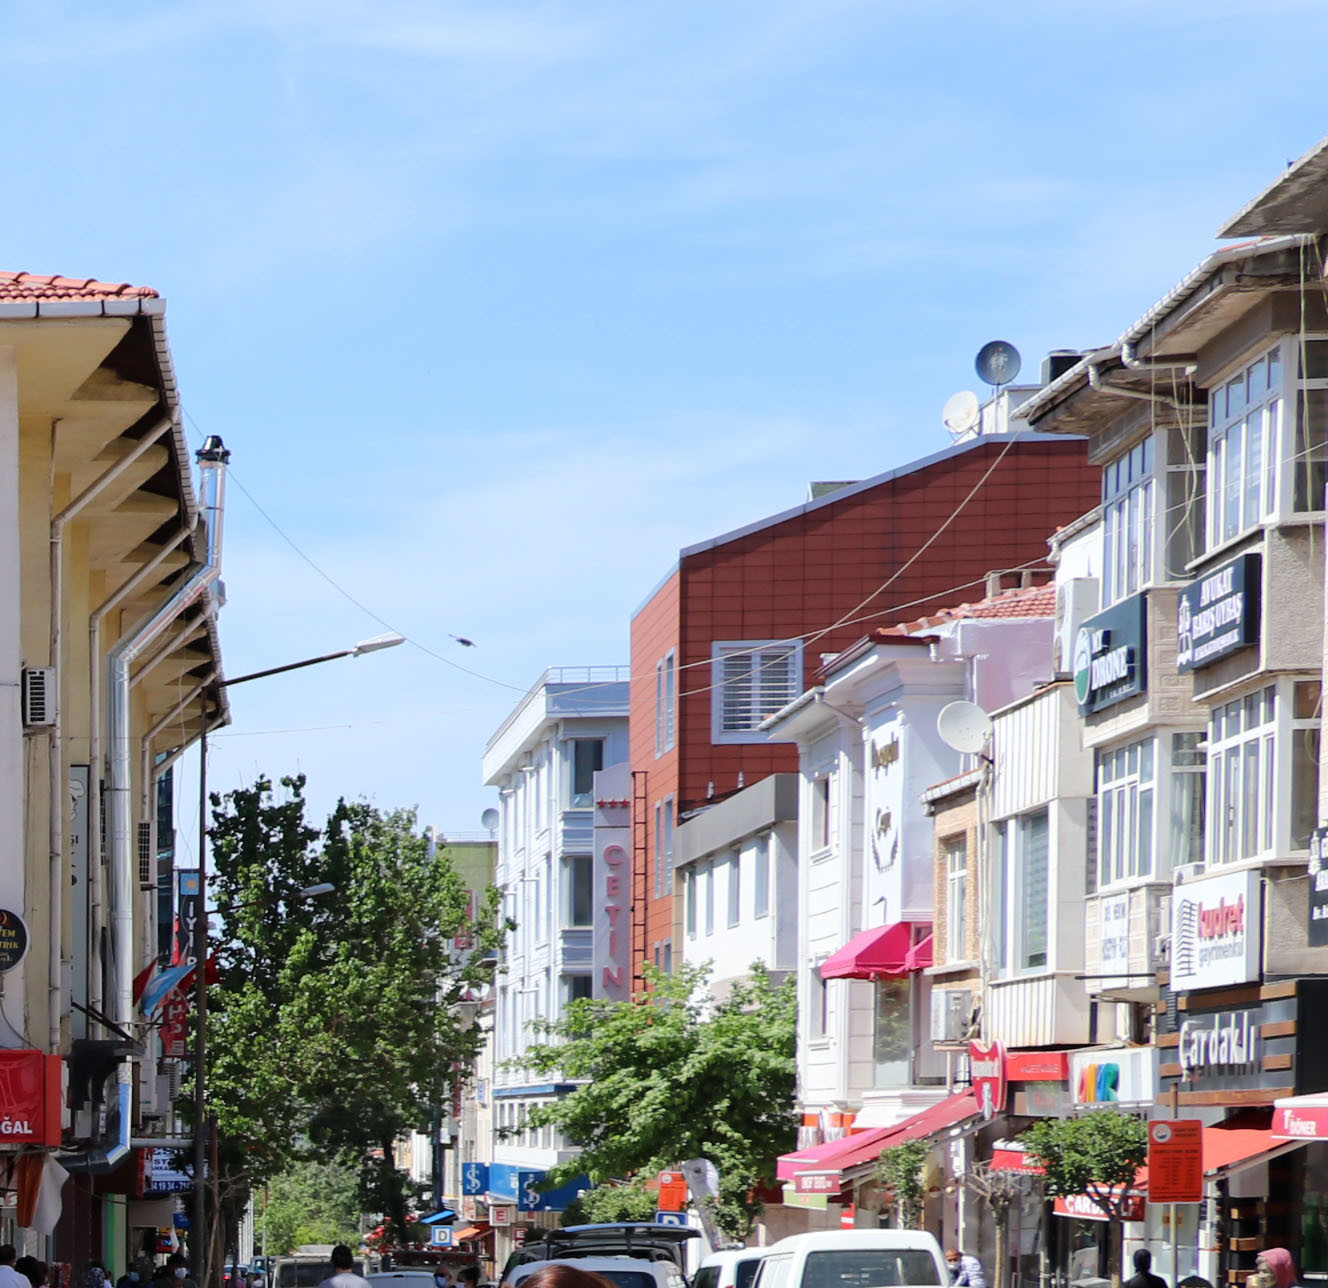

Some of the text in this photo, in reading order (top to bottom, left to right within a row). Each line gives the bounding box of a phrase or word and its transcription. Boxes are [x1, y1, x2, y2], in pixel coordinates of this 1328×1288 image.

[1091, 645, 1128, 691] DRONE
[1179, 1011, 1256, 1083] Çardaklı
[1289, 1117, 1317, 1136] DÖNER
